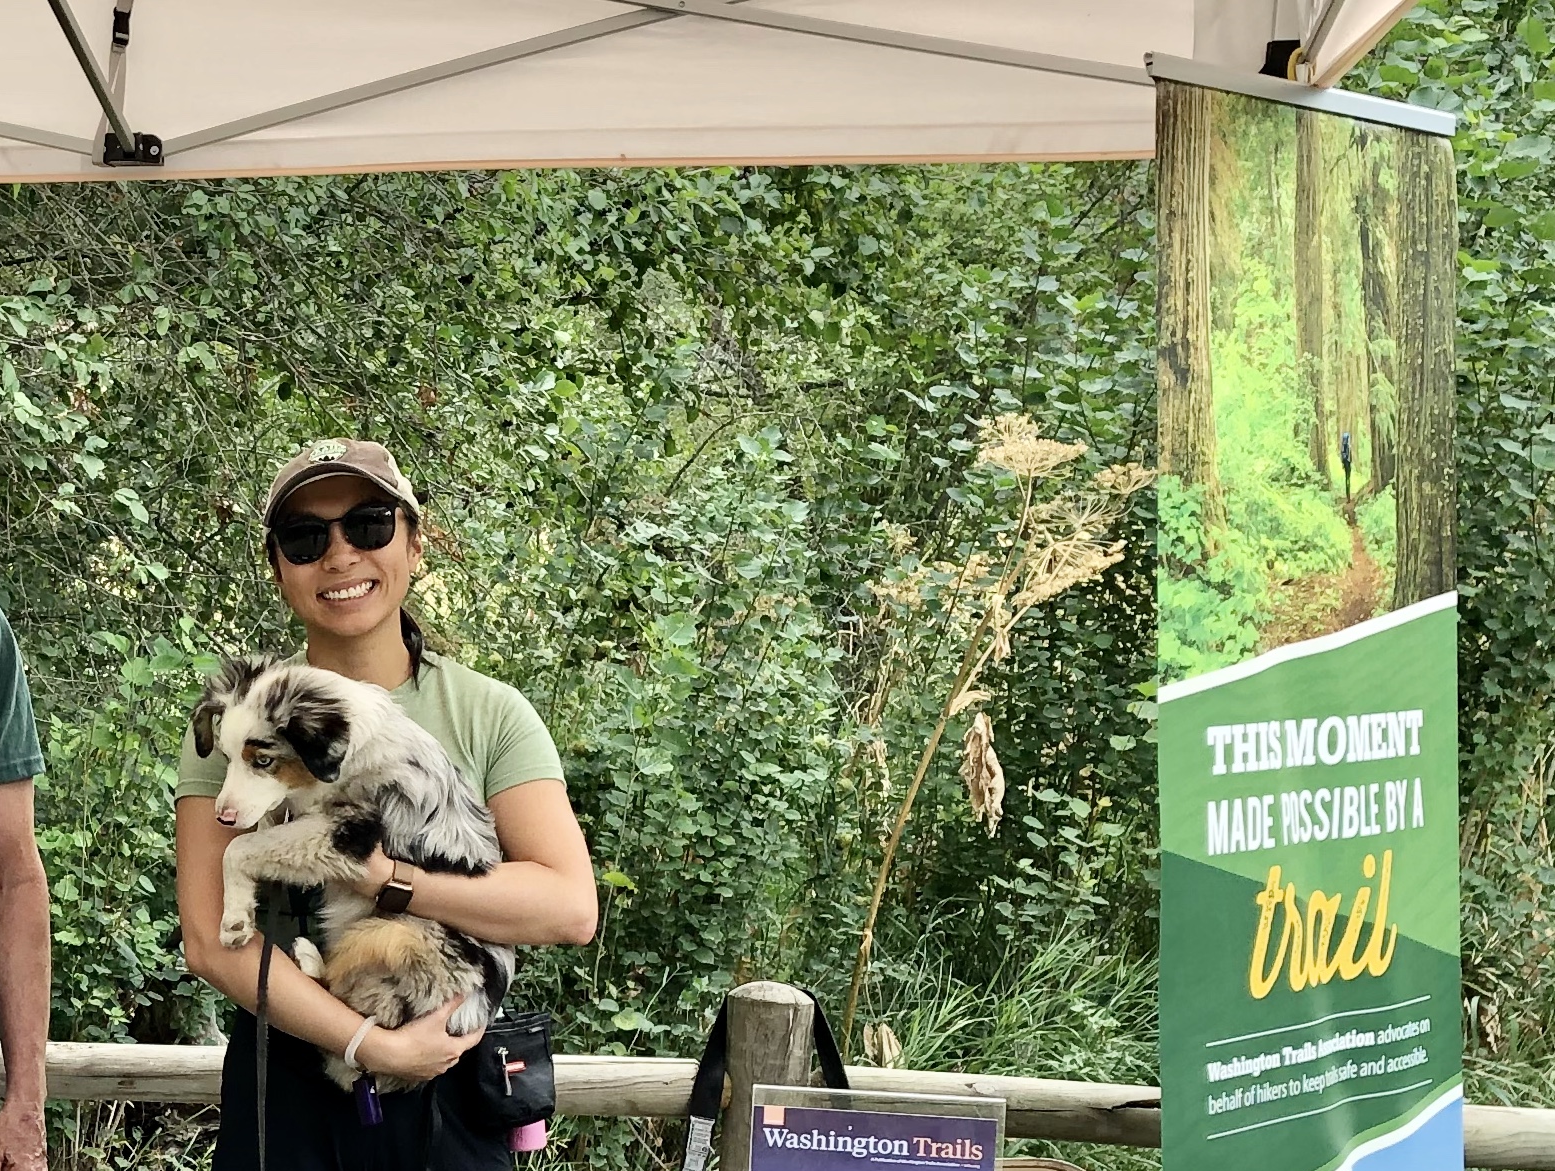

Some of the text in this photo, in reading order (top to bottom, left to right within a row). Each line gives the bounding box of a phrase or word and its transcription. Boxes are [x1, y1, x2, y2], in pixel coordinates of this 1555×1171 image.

[1207, 709, 1423, 776] THIS MOMENT
[1207, 777, 1425, 856] MADE POSSIBLE BY A
[1250, 849, 1398, 999] trail
[1207, 1052, 1281, 1083] Washington
[1282, 1043, 1317, 1066] Trails
[1377, 1020, 1419, 1044] advocates
[1420, 1018, 1431, 1033] on
[1208, 1088, 1243, 1116] behalf
[1244, 1086, 1256, 1107] of
[1257, 1081, 1288, 1102] hikers
[1288, 1079, 1301, 1096] to
[1302, 1073, 1326, 1095] keep
[1338, 1059, 1358, 1082] safe
[1359, 1054, 1386, 1077] and
[1386, 1045, 1430, 1073] accessible.
[763, 1127, 983, 1160] Washington Trails
